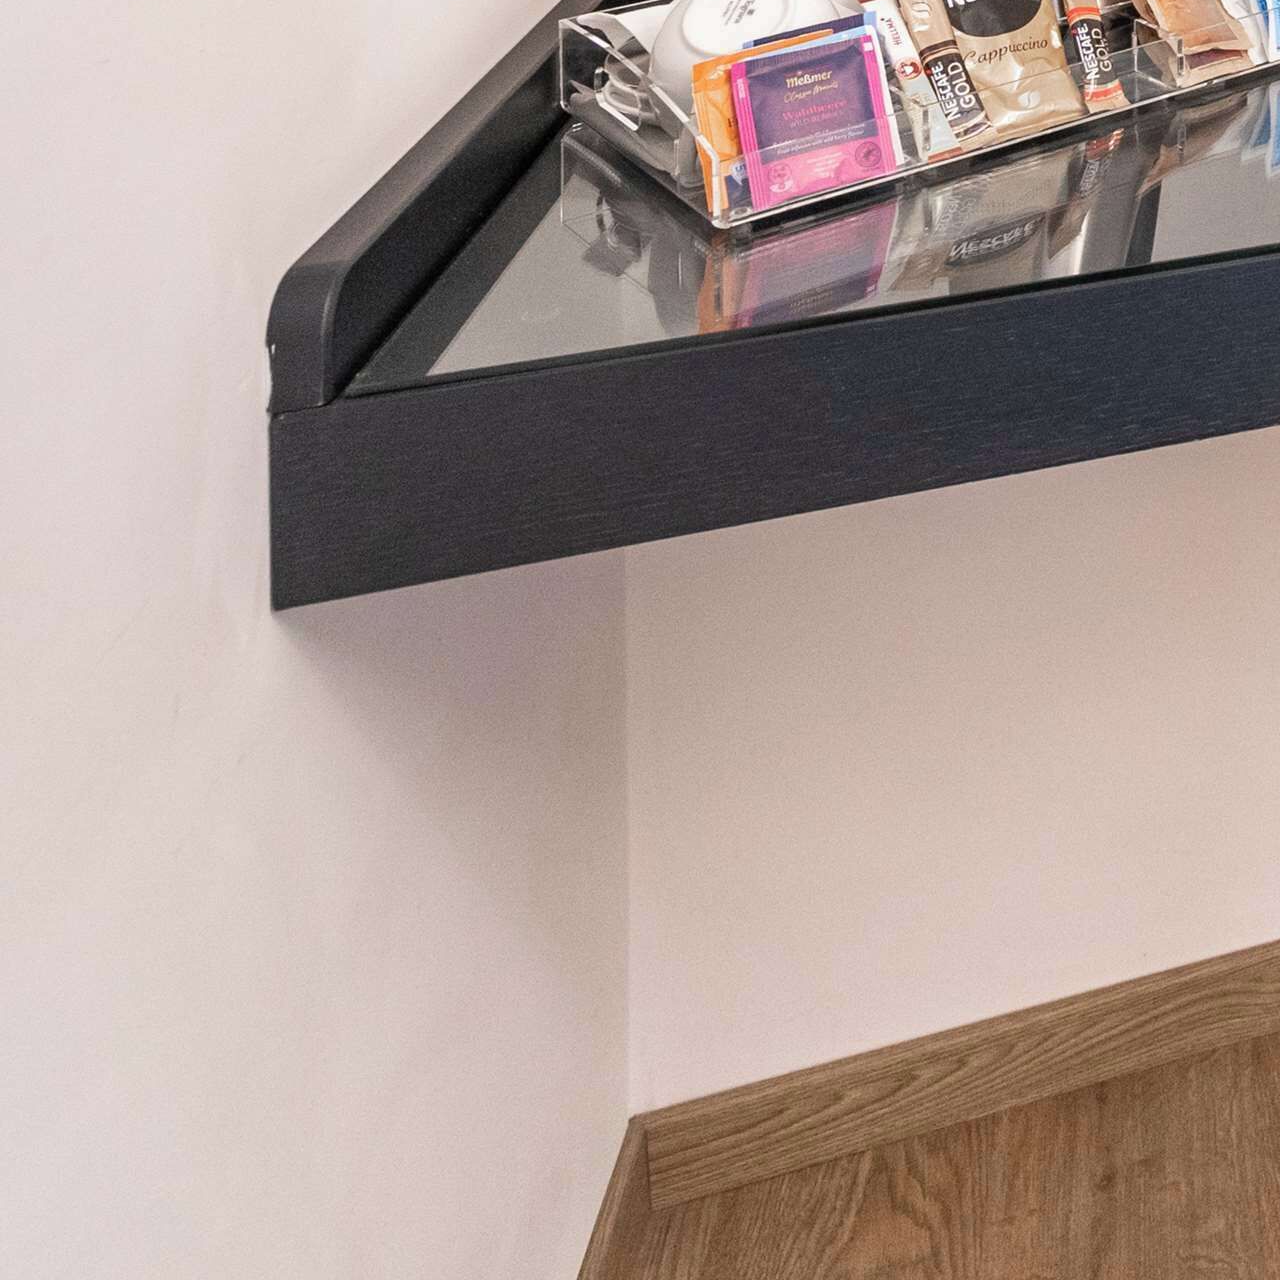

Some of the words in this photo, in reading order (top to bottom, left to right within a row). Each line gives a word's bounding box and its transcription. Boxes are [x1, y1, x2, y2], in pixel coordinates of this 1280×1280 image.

[964, 36, 1049, 65] Cappuccino
[1091, 28, 1112, 72] GOLD
[786, 70, 833, 89] Meßmer
[947, 61, 976, 108] GOLD
